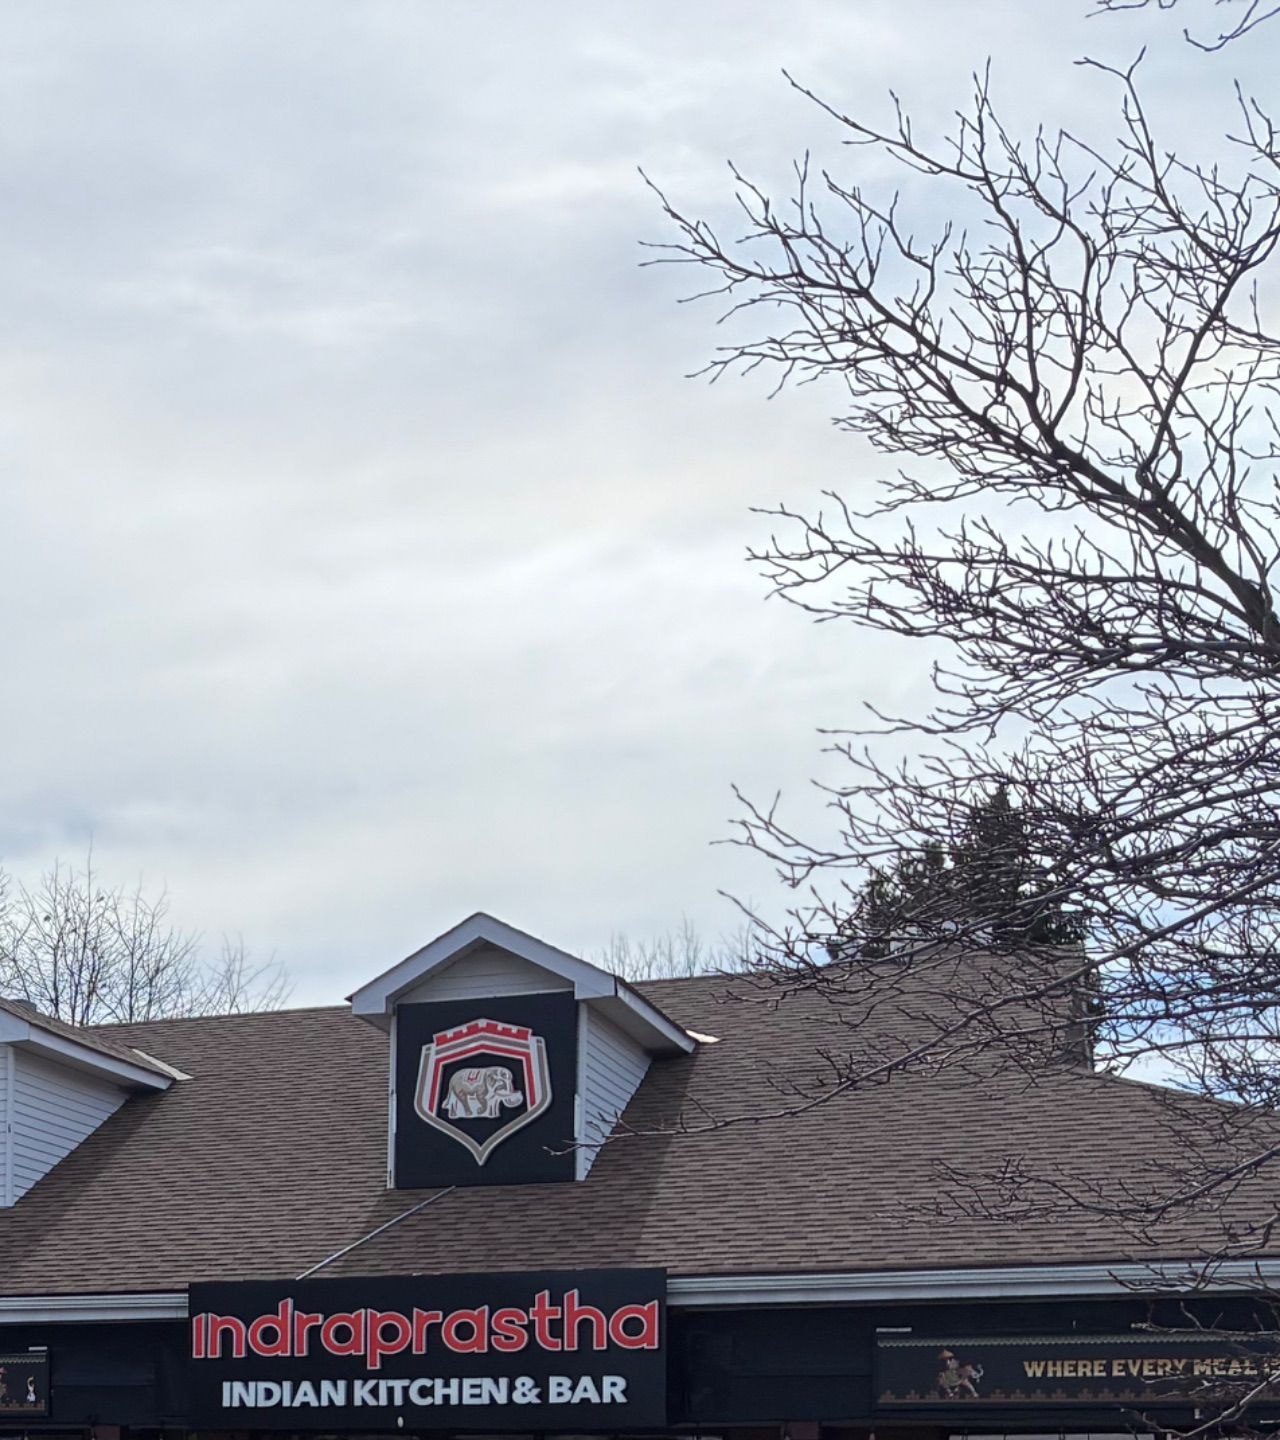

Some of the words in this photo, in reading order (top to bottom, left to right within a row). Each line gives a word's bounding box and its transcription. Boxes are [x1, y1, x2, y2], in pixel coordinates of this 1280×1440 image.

[1023, 1359, 1107, 1378] WHERE
[1112, 1358, 1187, 1377] EVERY
[222, 1379, 347, 1408] INDIAN
[353, 1377, 509, 1407] KITCHEN
[512, 1375, 542, 1405] &
[548, 1375, 628, 1404] BAR
